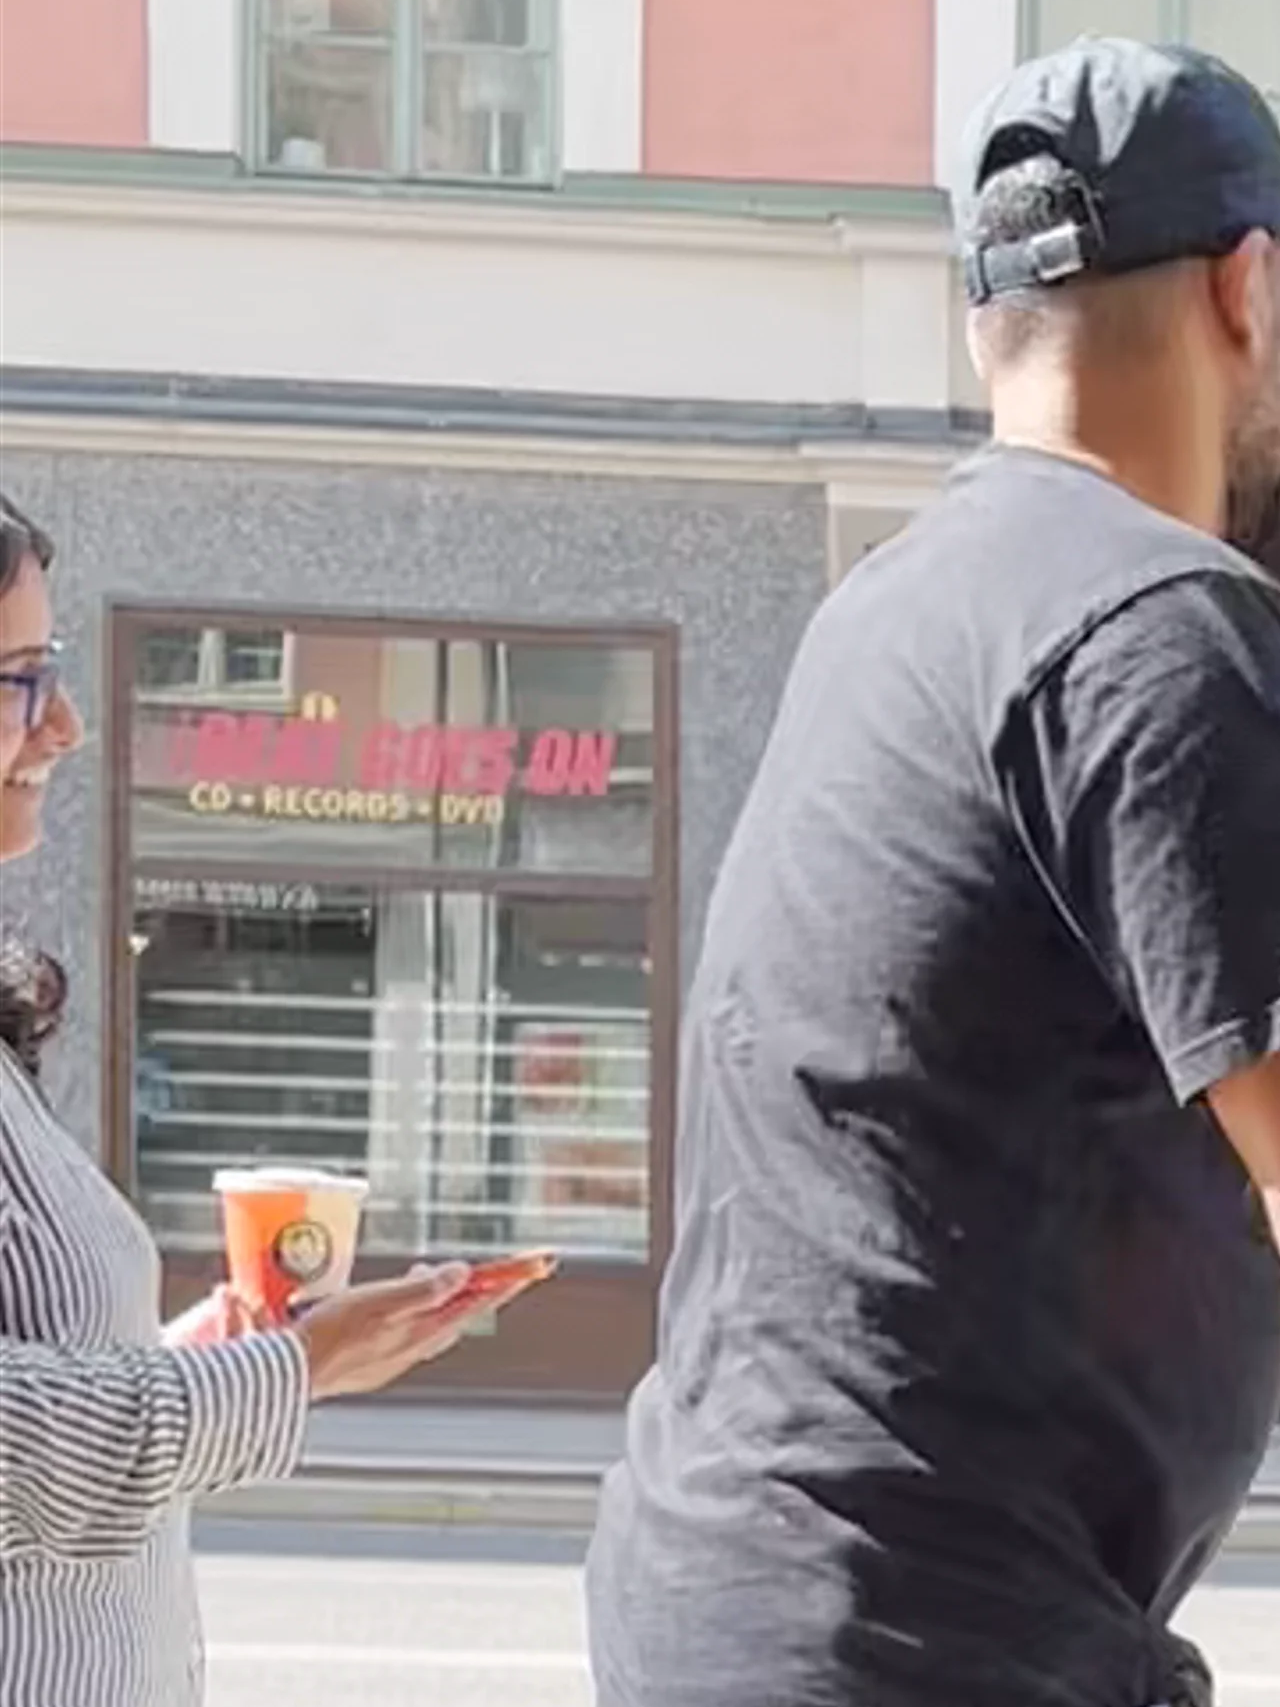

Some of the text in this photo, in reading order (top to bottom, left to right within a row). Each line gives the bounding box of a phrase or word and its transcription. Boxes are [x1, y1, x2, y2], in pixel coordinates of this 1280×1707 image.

[525, 728, 616, 795] ON
[188, 780, 504, 825] CD RECORDS DVD
